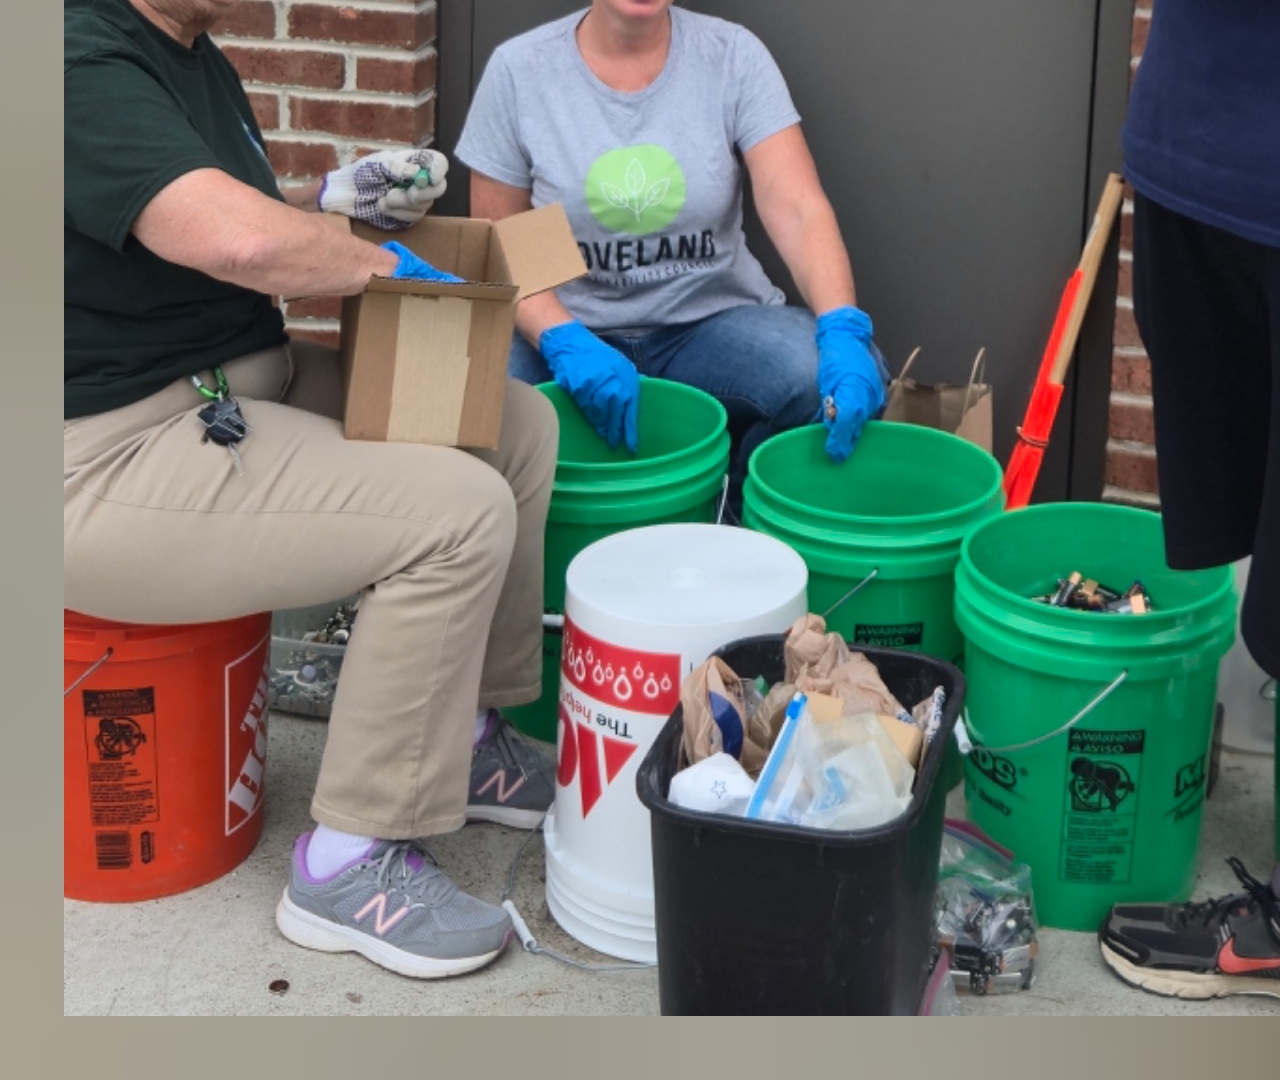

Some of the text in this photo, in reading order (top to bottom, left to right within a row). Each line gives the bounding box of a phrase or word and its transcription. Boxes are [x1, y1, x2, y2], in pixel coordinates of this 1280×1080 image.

[596, 712, 633, 739] The
[1081, 731, 1143, 743] WARNING
[1090, 744, 1125, 754] AVISO
